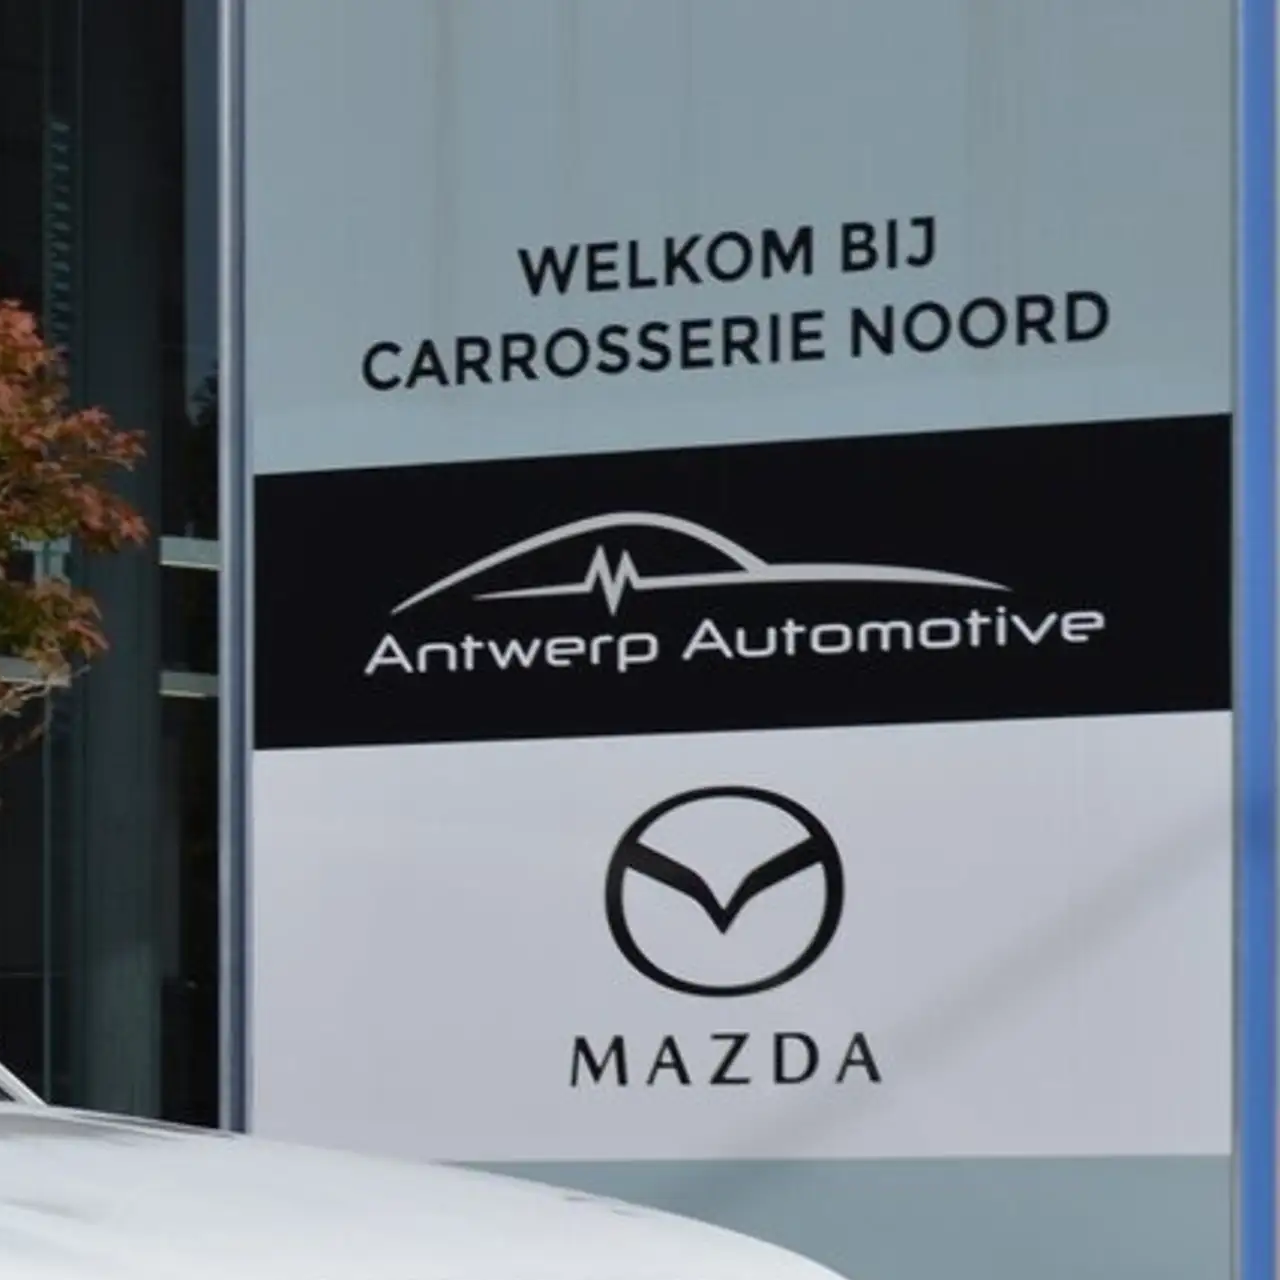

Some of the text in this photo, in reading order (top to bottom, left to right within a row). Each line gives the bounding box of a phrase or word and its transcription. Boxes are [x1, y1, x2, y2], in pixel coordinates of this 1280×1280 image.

[518, 215, 935, 297] WELKOM BIJ
[362, 291, 1110, 391] CARROSSERIE NOORD
[364, 607, 1107, 675] Antwerp Automotive
[571, 1032, 882, 1088] MAZDA
